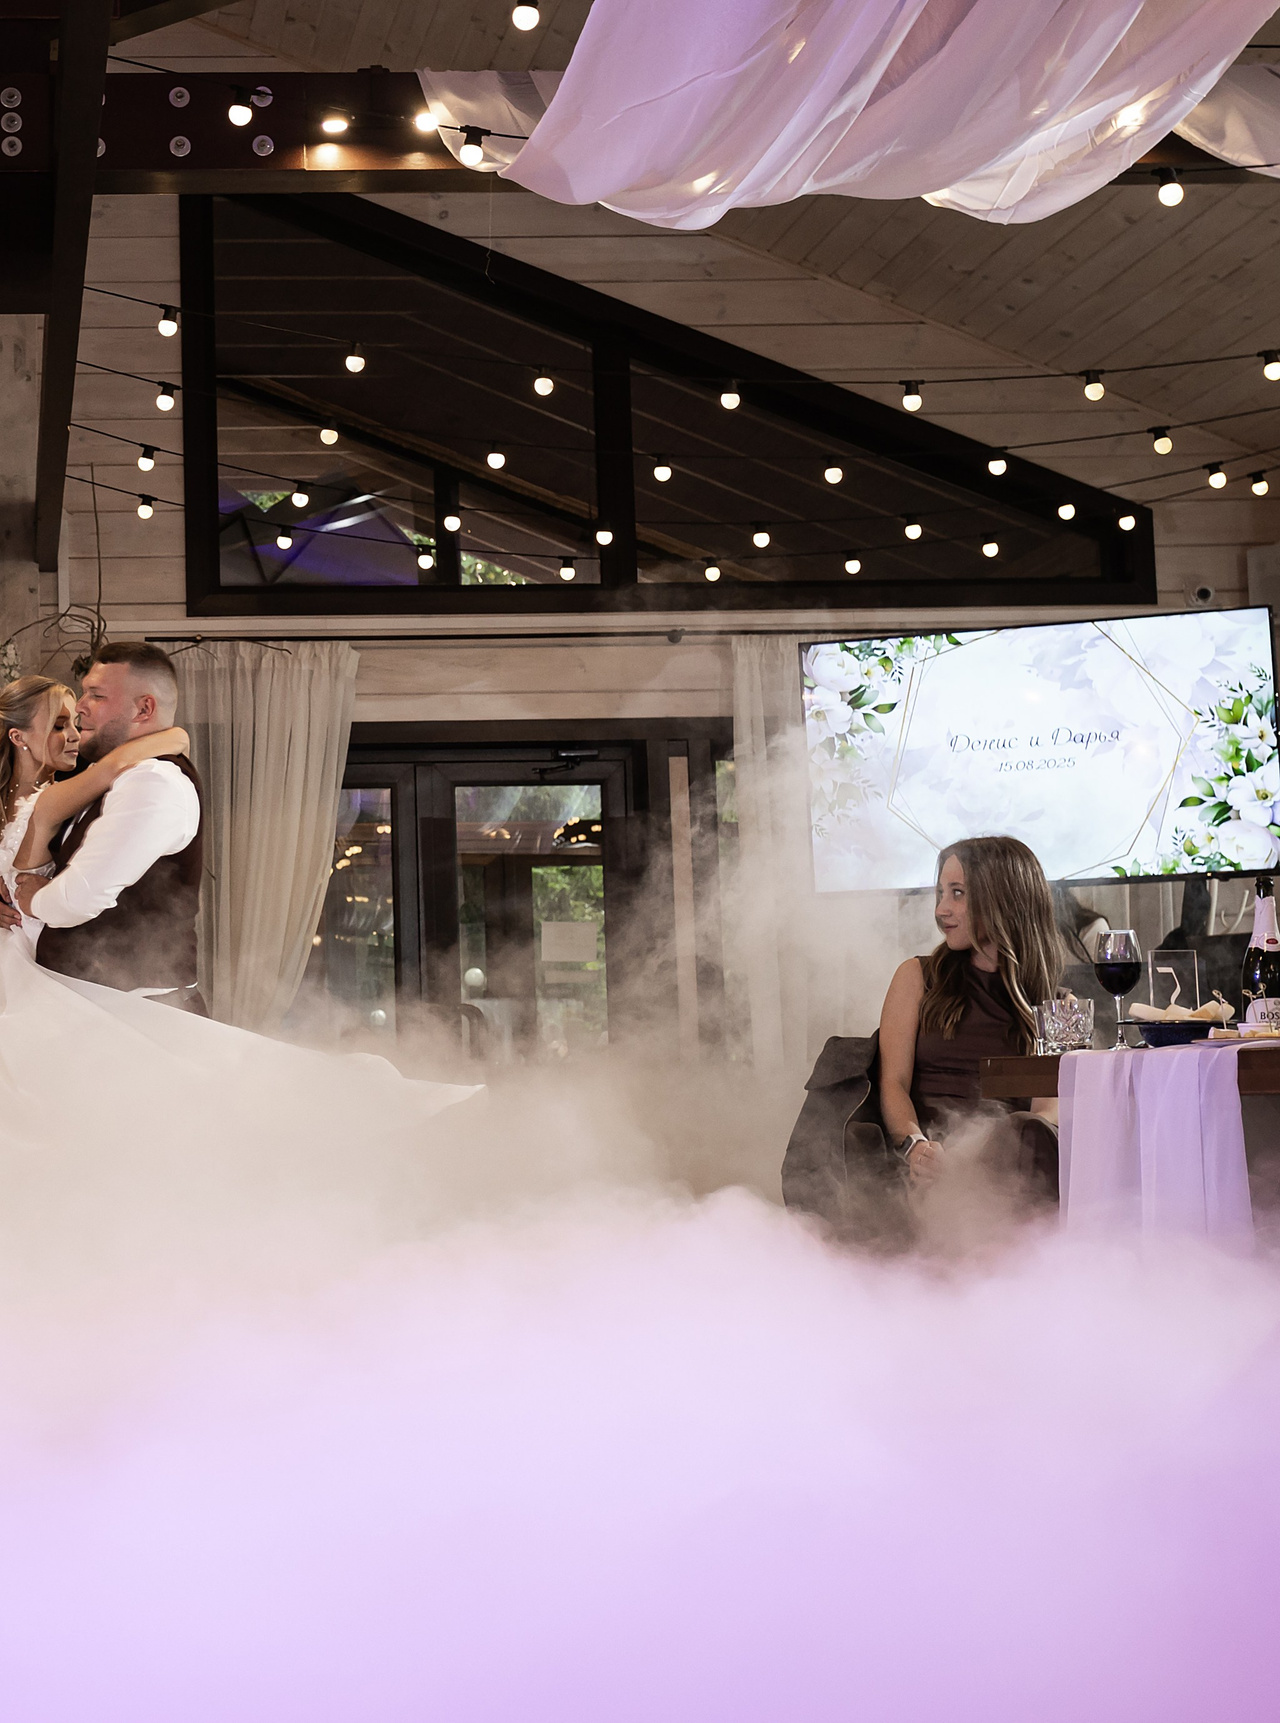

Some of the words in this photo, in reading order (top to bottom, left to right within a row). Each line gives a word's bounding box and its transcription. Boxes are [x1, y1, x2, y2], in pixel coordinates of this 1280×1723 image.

[949, 734, 1018, 753] Денис
[1029, 735, 1040, 748] и
[1051, 727, 1120, 750] Дарья
[999, 757, 1076, 772] 15.08.2025
